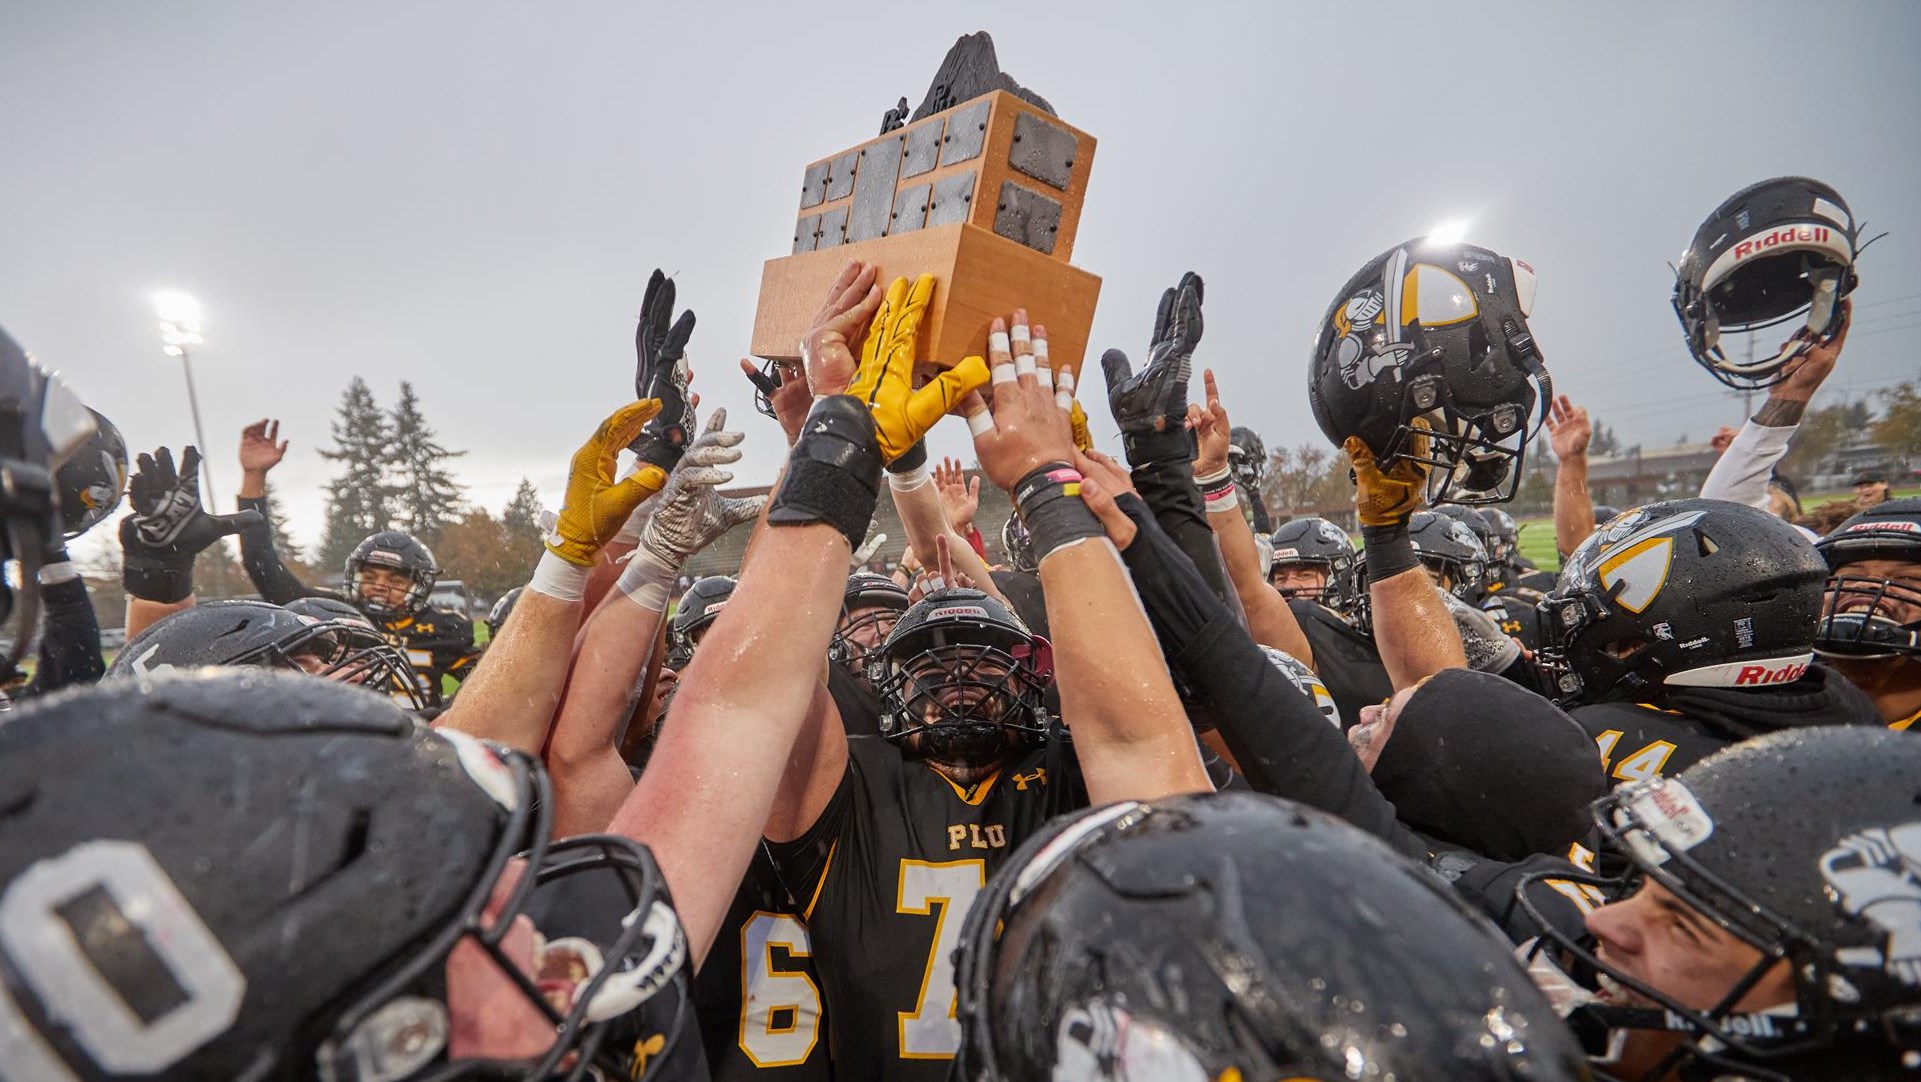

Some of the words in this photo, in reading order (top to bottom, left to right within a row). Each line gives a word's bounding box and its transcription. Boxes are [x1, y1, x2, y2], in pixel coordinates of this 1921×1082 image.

[1734, 228, 1829, 260] Riddell
[947, 823, 1006, 850] PLU
[738, 909, 822, 1069] 6
[896, 858, 986, 1060] 7
